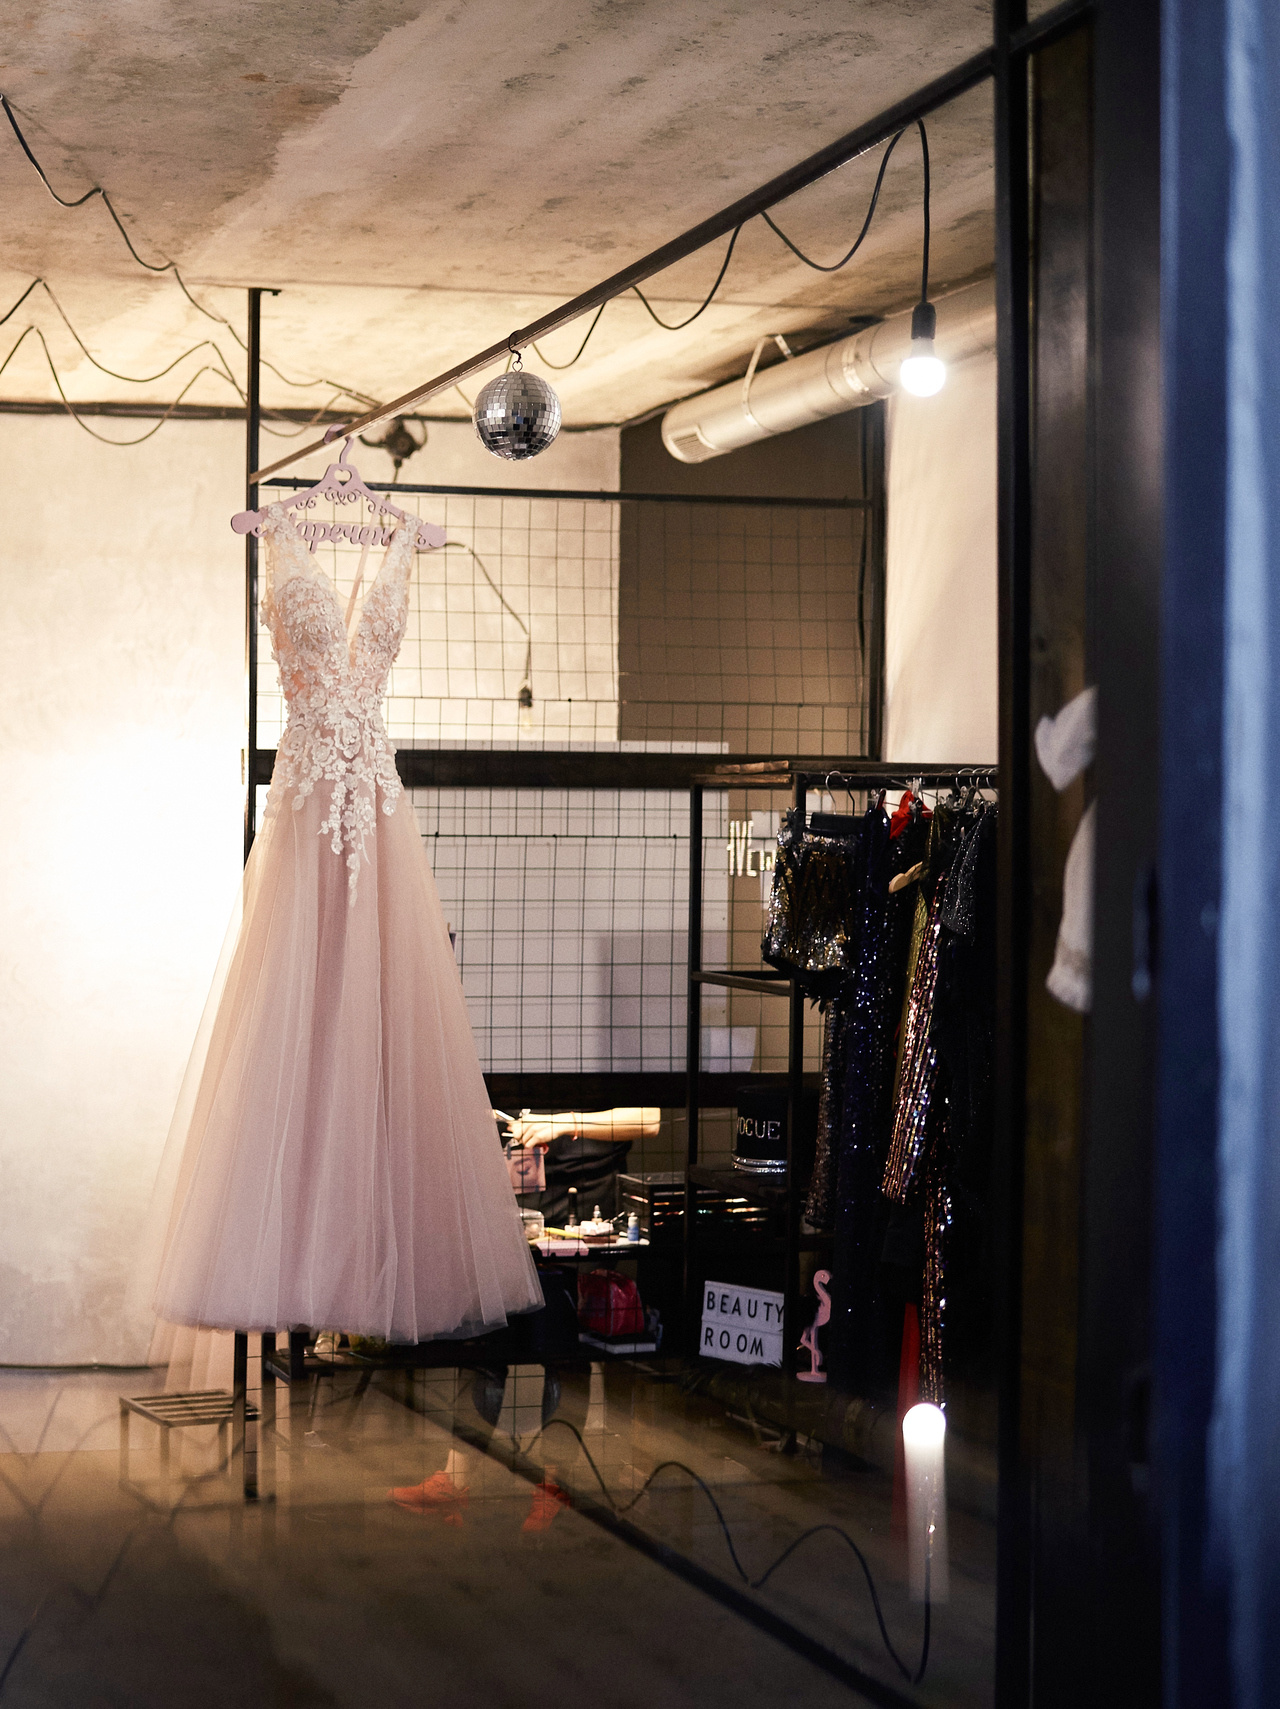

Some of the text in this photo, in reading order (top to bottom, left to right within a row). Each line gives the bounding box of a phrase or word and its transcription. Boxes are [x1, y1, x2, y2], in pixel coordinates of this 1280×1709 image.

[289, 511, 396, 554] аречен
[706, 1290, 785, 1324] BEAUTY
[704, 1327, 764, 1358] ROOM
